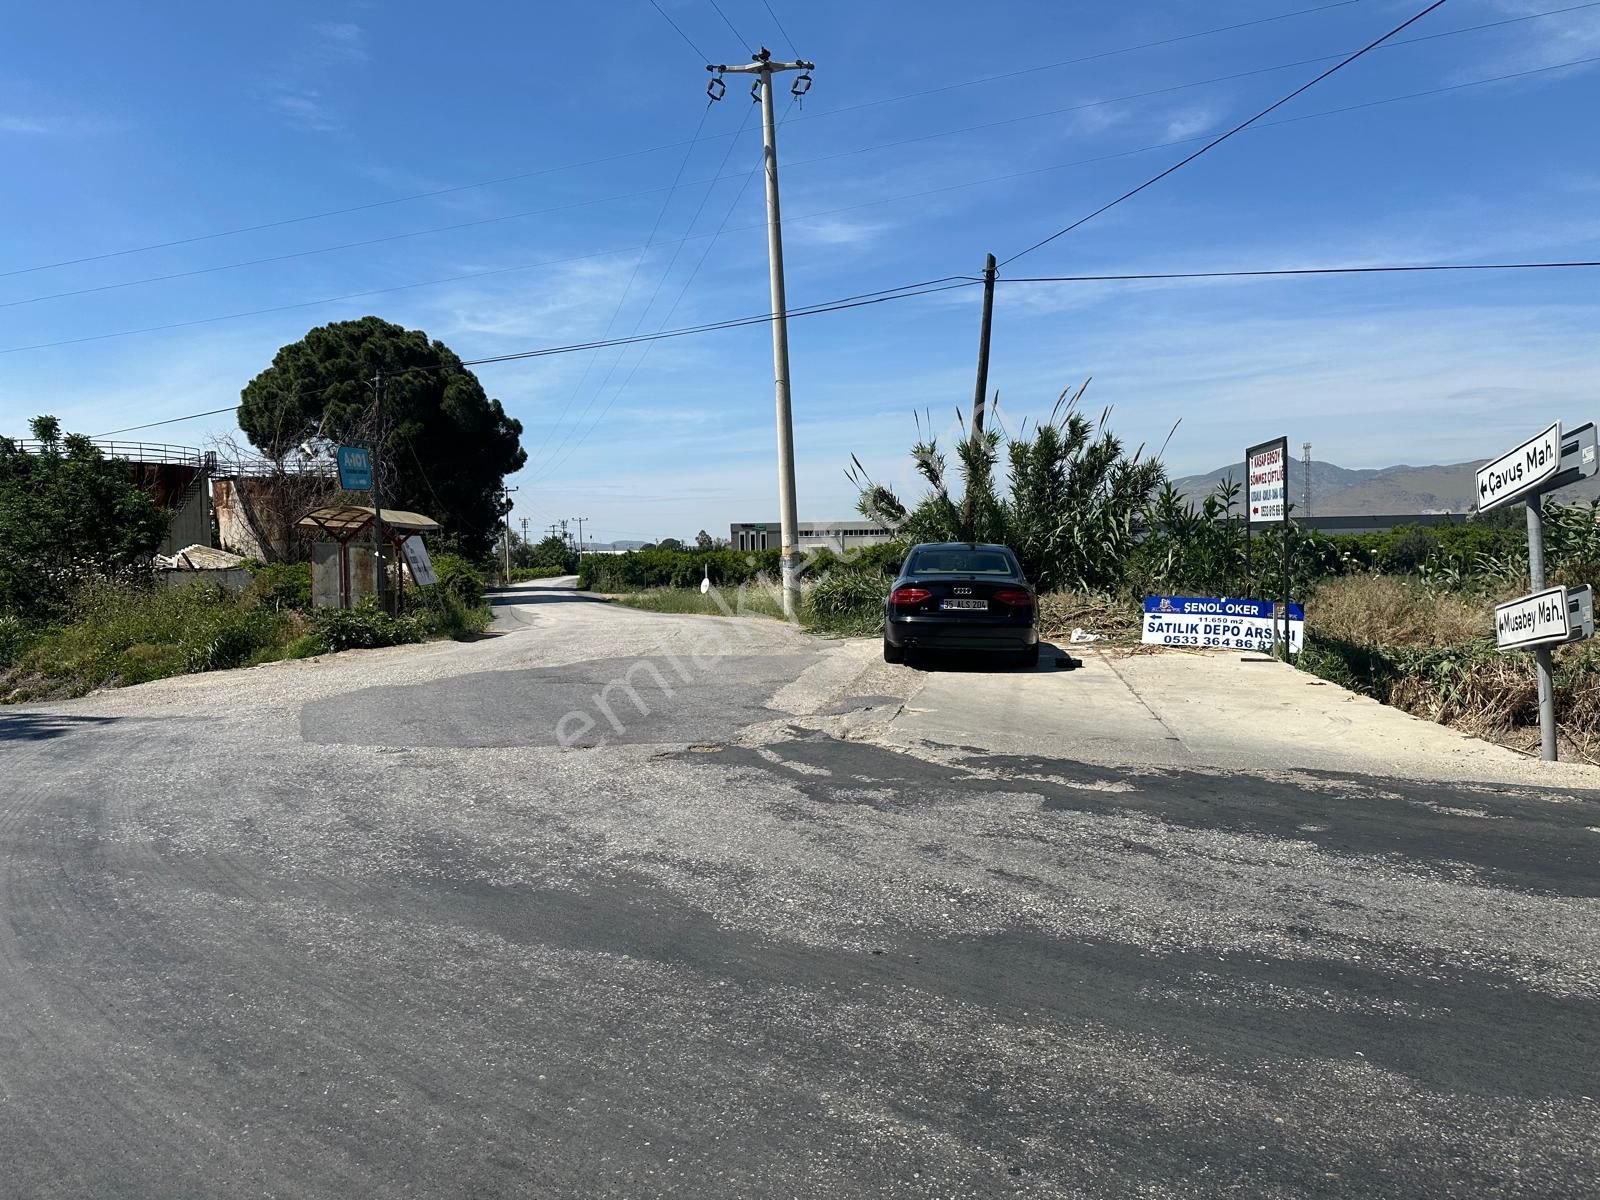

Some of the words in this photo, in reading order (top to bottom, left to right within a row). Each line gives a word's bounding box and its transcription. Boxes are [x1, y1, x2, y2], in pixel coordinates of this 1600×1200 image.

[1488, 462, 1523, 496] Çavuş
[1526, 439, 1554, 473] Mah.
[957, 600, 970, 609] ALS
[1184, 602, 1223, 614] ŞENOL
[1225, 603, 1259, 615] OKER
[1503, 607, 1537, 633] Musabey
[1538, 598, 1563, 625] Mah.
[1147, 622, 1199, 635] SATILIK
[1204, 625, 1241, 637] DEPO
[1164, 635, 1198, 645] 0533
[1203, 637, 1231, 647] 364
[1235, 639, 1253, 648] 86
